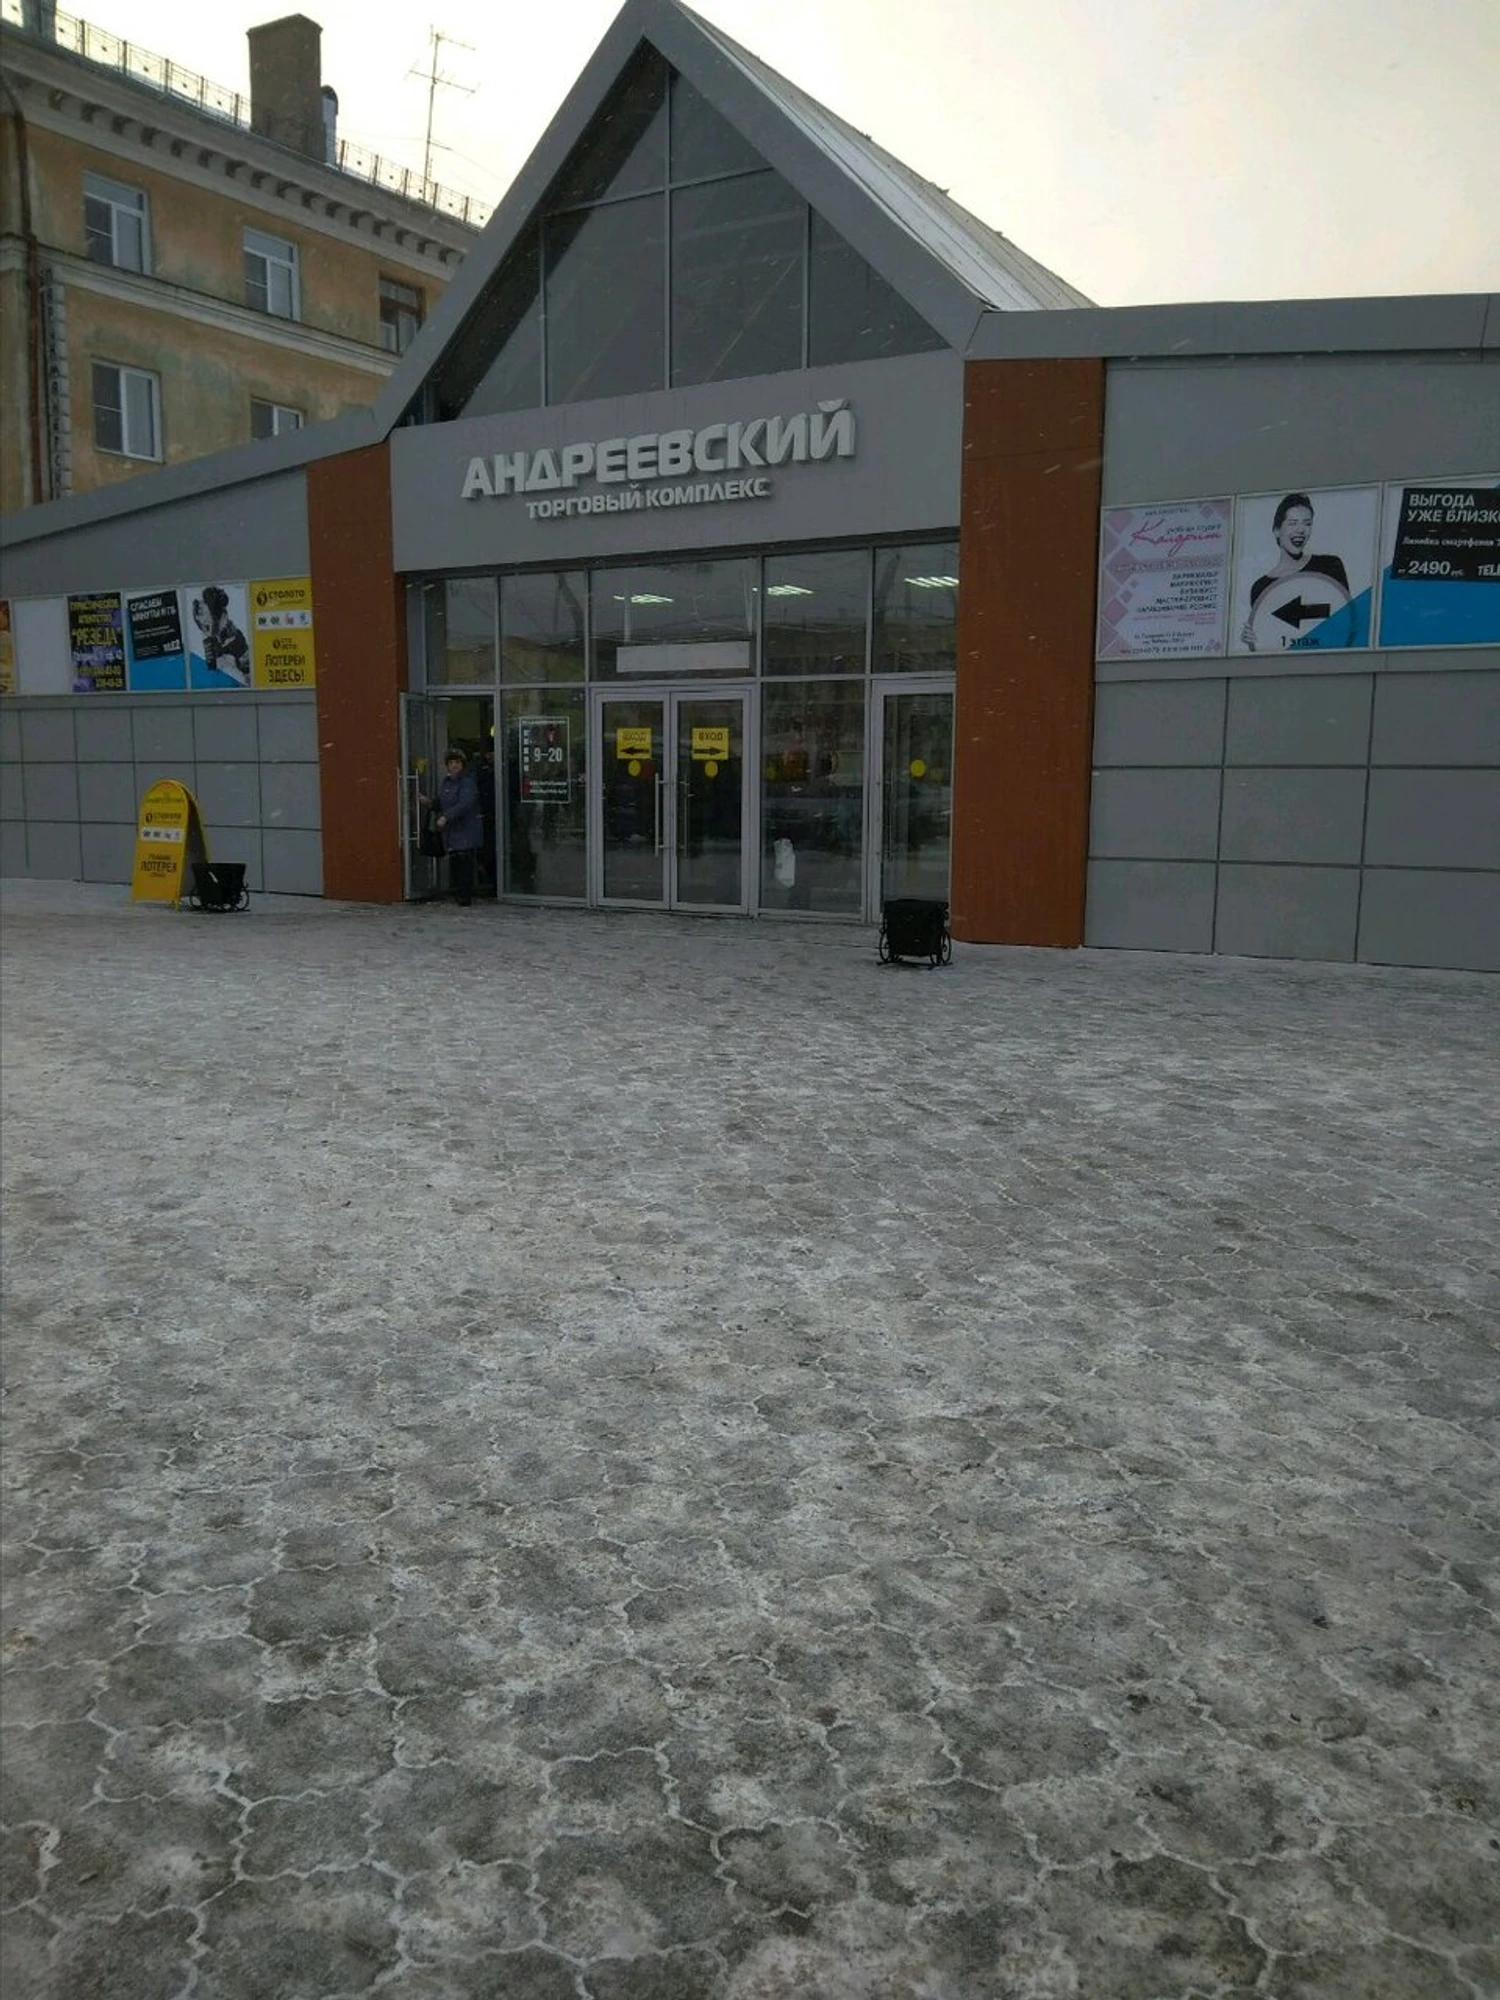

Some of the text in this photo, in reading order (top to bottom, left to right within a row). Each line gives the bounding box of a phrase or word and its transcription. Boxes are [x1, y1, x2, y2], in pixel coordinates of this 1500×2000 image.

[461, 398, 857, 499] АНДРЕЕВСКИЙ
[526, 477, 774, 520] ТОРГОВЫЙ КОМПЛЕКС
[1409, 494, 1475, 508] ВЫГОДА
[1407, 509, 1443, 522] УЖЕ
[1408, 561, 1451, 575] 2490
[269, 589, 305, 600] СТОЛОТО
[1280, 636, 1321, 646] 1 этаж
[269, 669, 304, 683] ЗДЕСЬ!
[699, 731, 723, 741] ВХОД
[534, 747, 562, 762] 9-20
